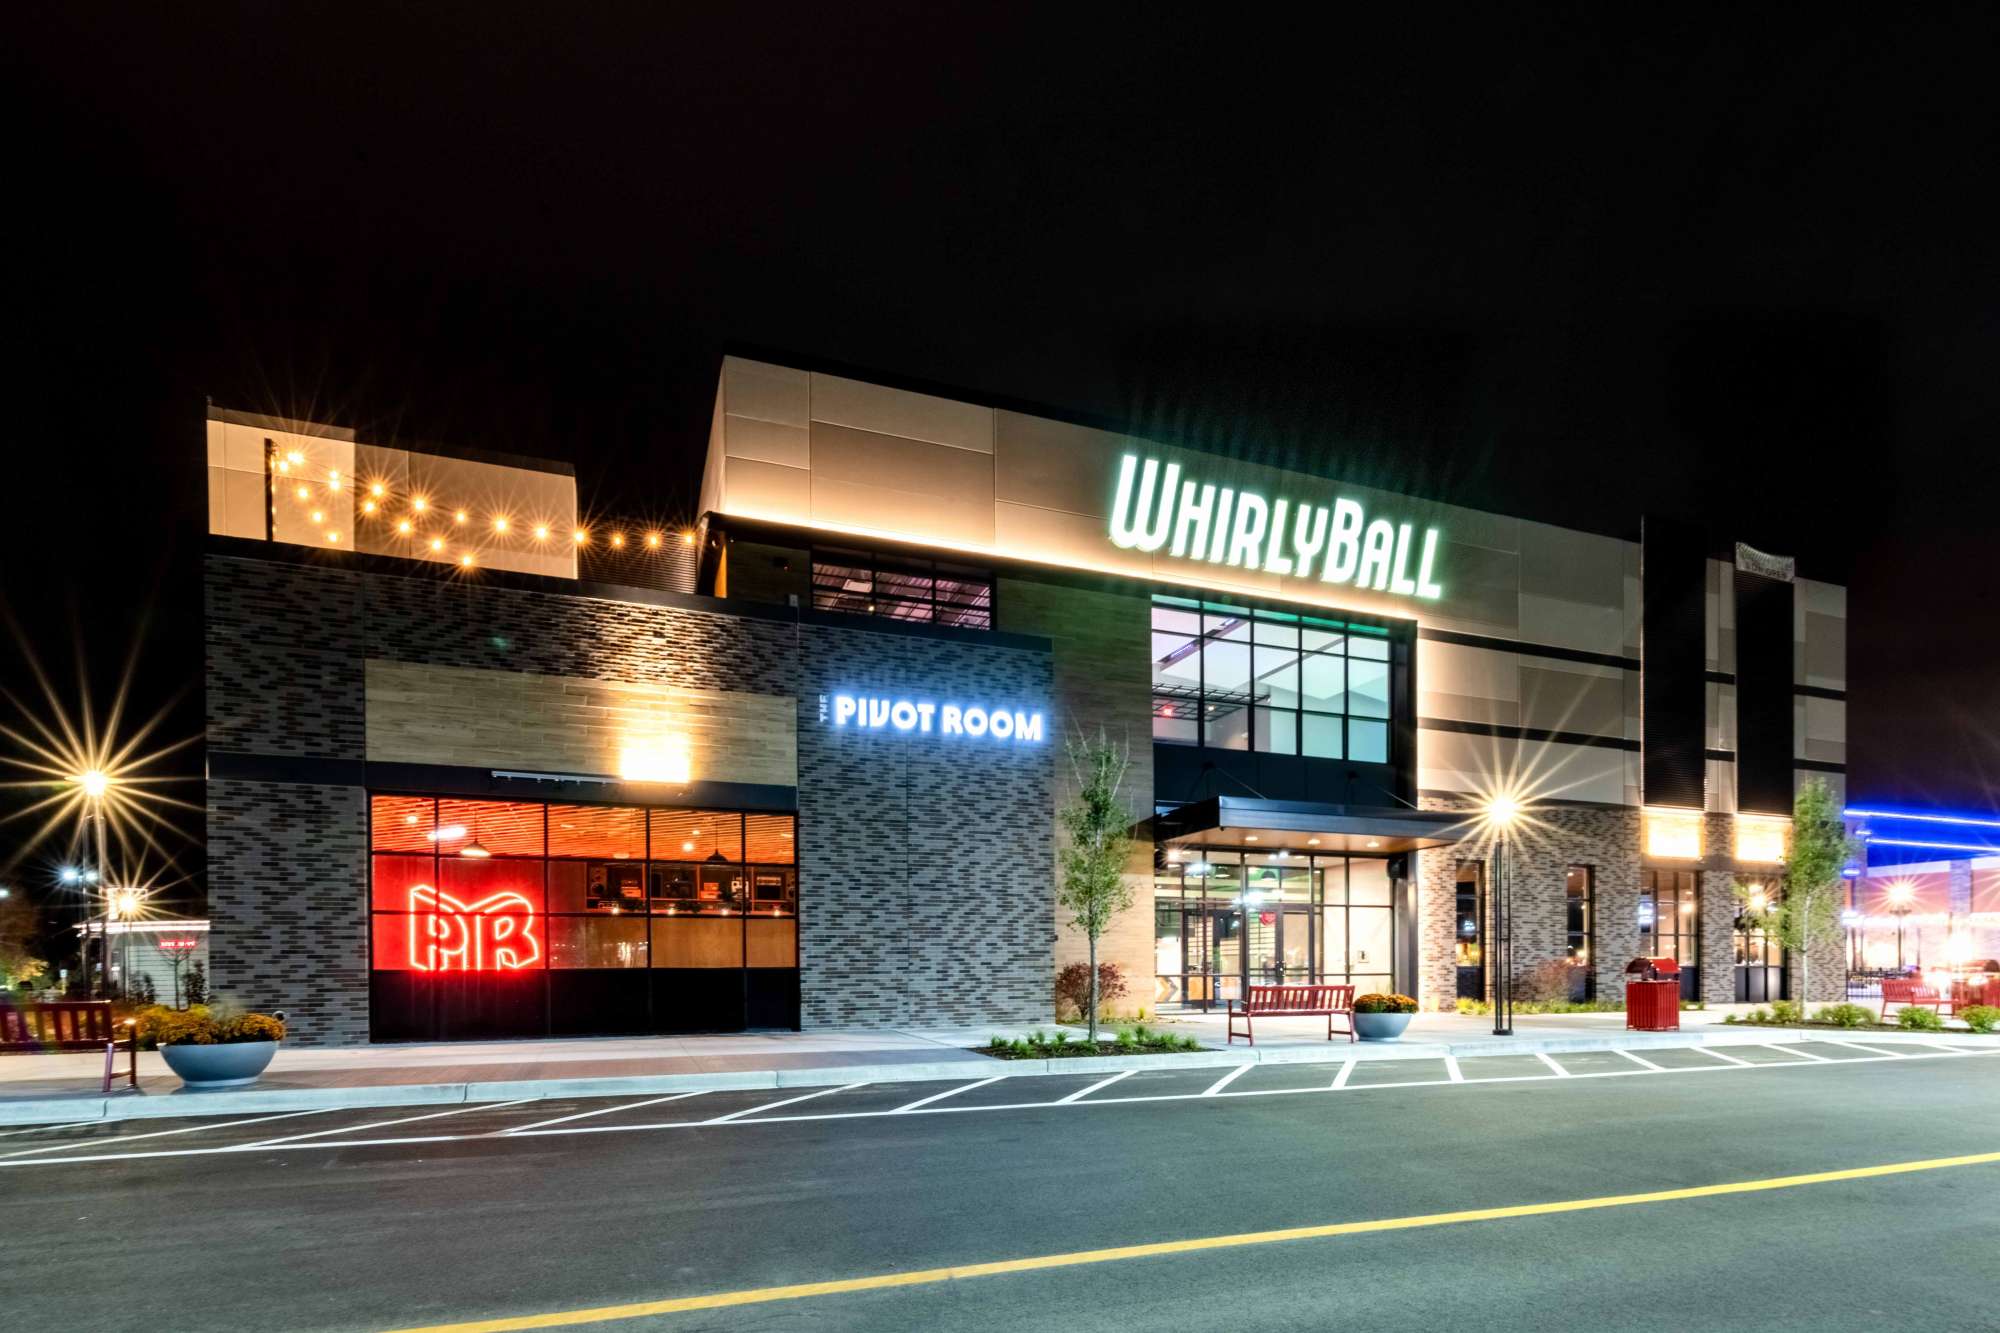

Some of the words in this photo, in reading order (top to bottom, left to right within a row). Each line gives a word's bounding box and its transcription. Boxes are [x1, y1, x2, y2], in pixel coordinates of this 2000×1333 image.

[1109, 454, 1442, 600] WHIRLYBALL
[819, 694, 829, 723] THE
[835, 696, 935, 732] PIVOT
[942, 705, 1041, 741] ROOM
